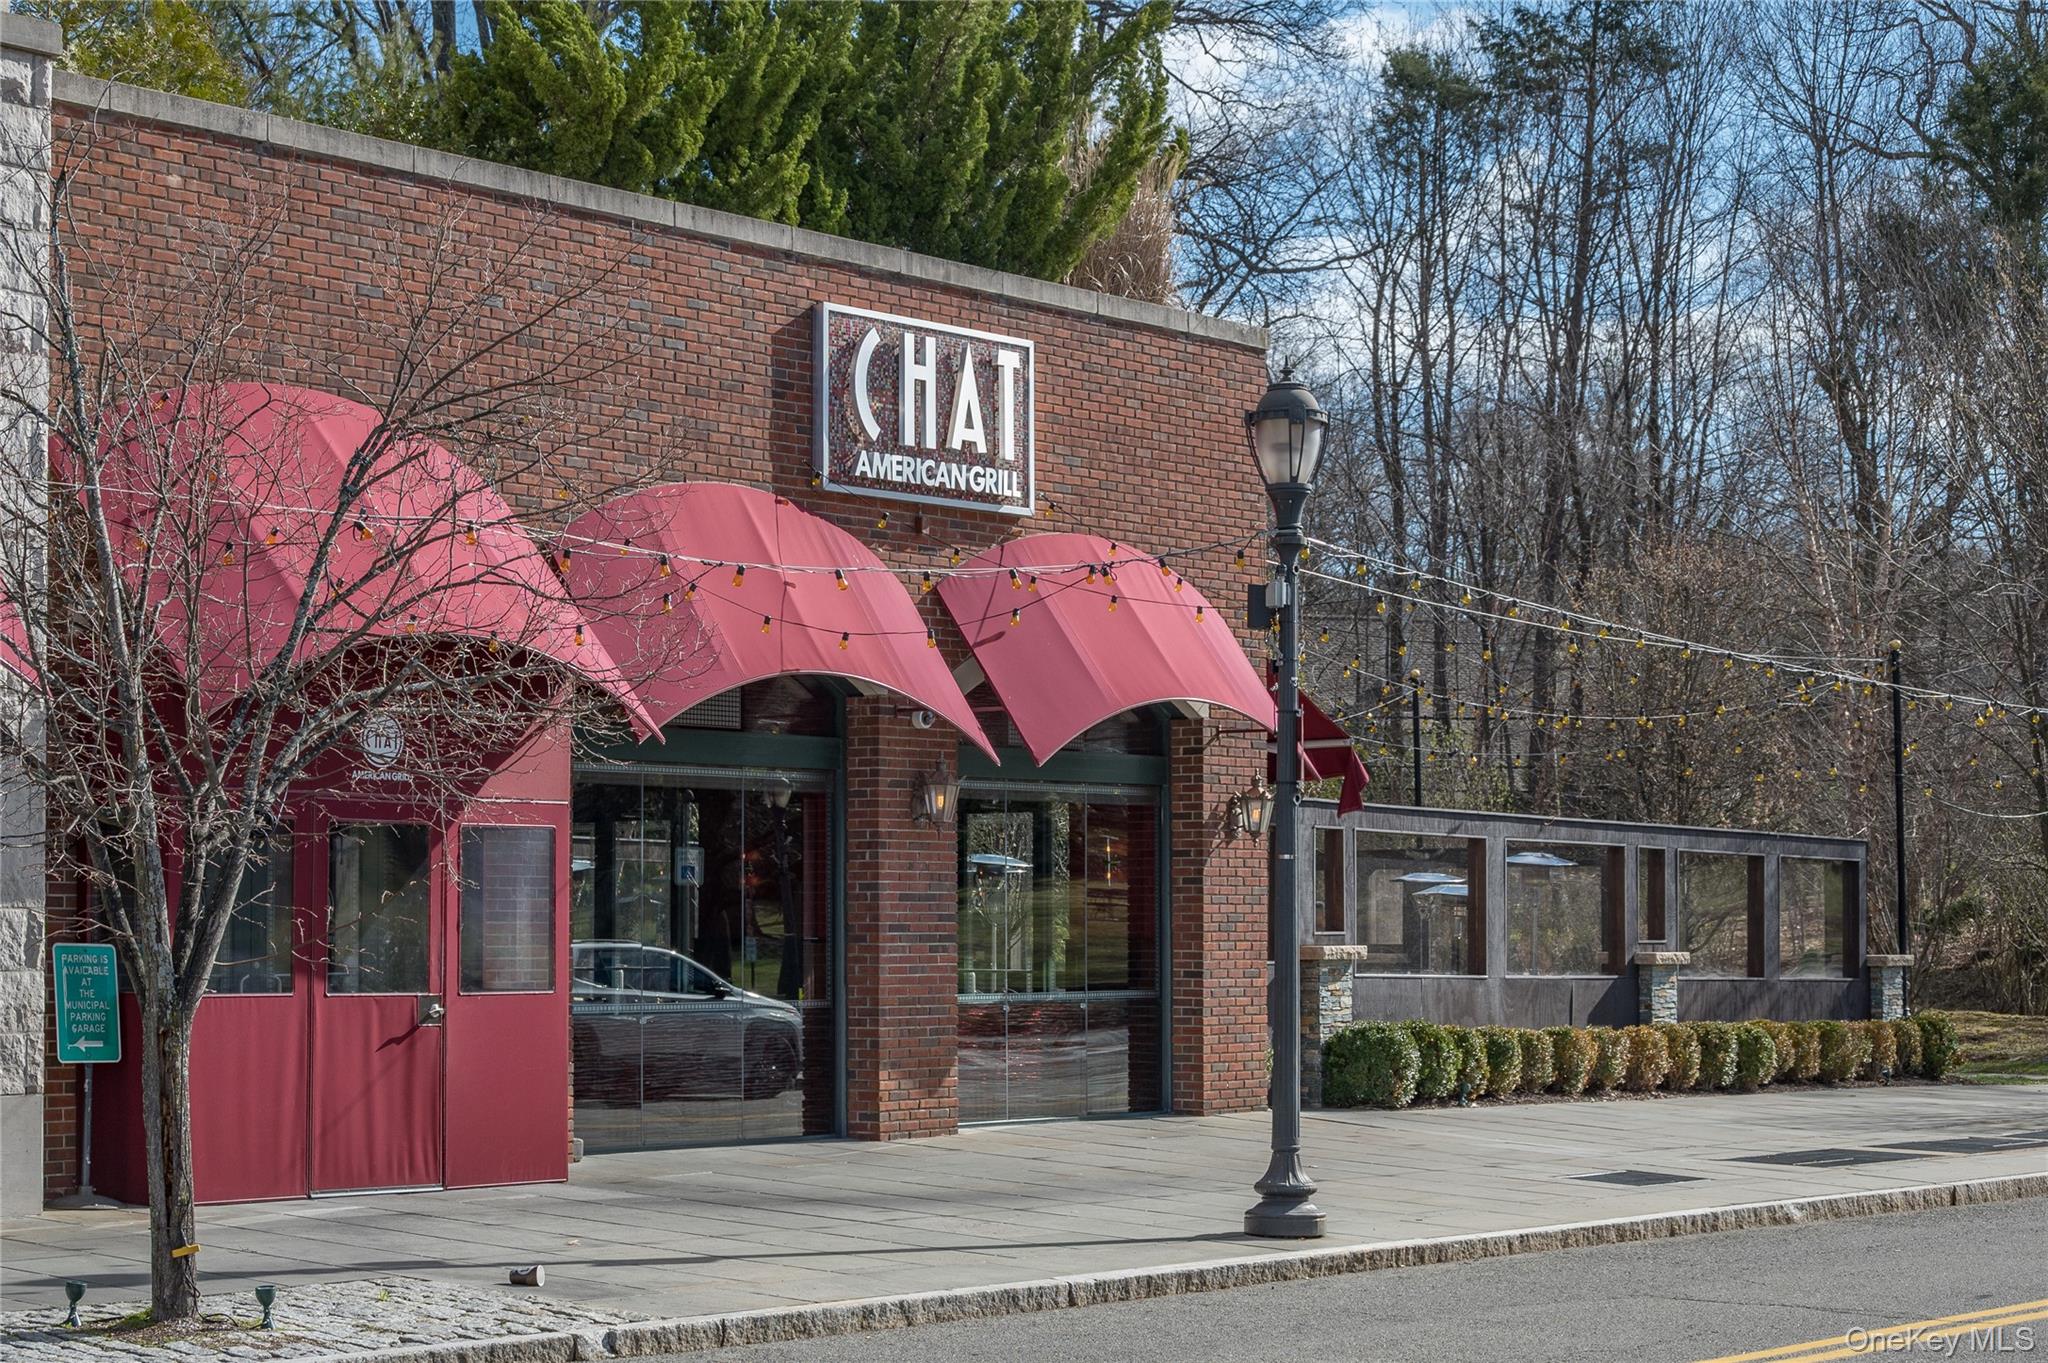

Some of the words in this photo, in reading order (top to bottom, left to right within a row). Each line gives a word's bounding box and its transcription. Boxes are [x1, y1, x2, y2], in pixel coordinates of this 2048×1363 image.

[854, 327, 1020, 461] CHAT
[854, 450, 966, 491] AMERICAN
[969, 466, 1021, 498] GRILL
[62, 954, 97, 963] PARKING
[101, 954, 109, 963] IS
[81, 978, 92, 986] AT
[79, 989, 95, 998] THE
[66, 1000, 110, 1009] MUNICIPAL
[70, 1012, 106, 1021] PARKING
[72, 1023, 105, 1033] GARAGE
